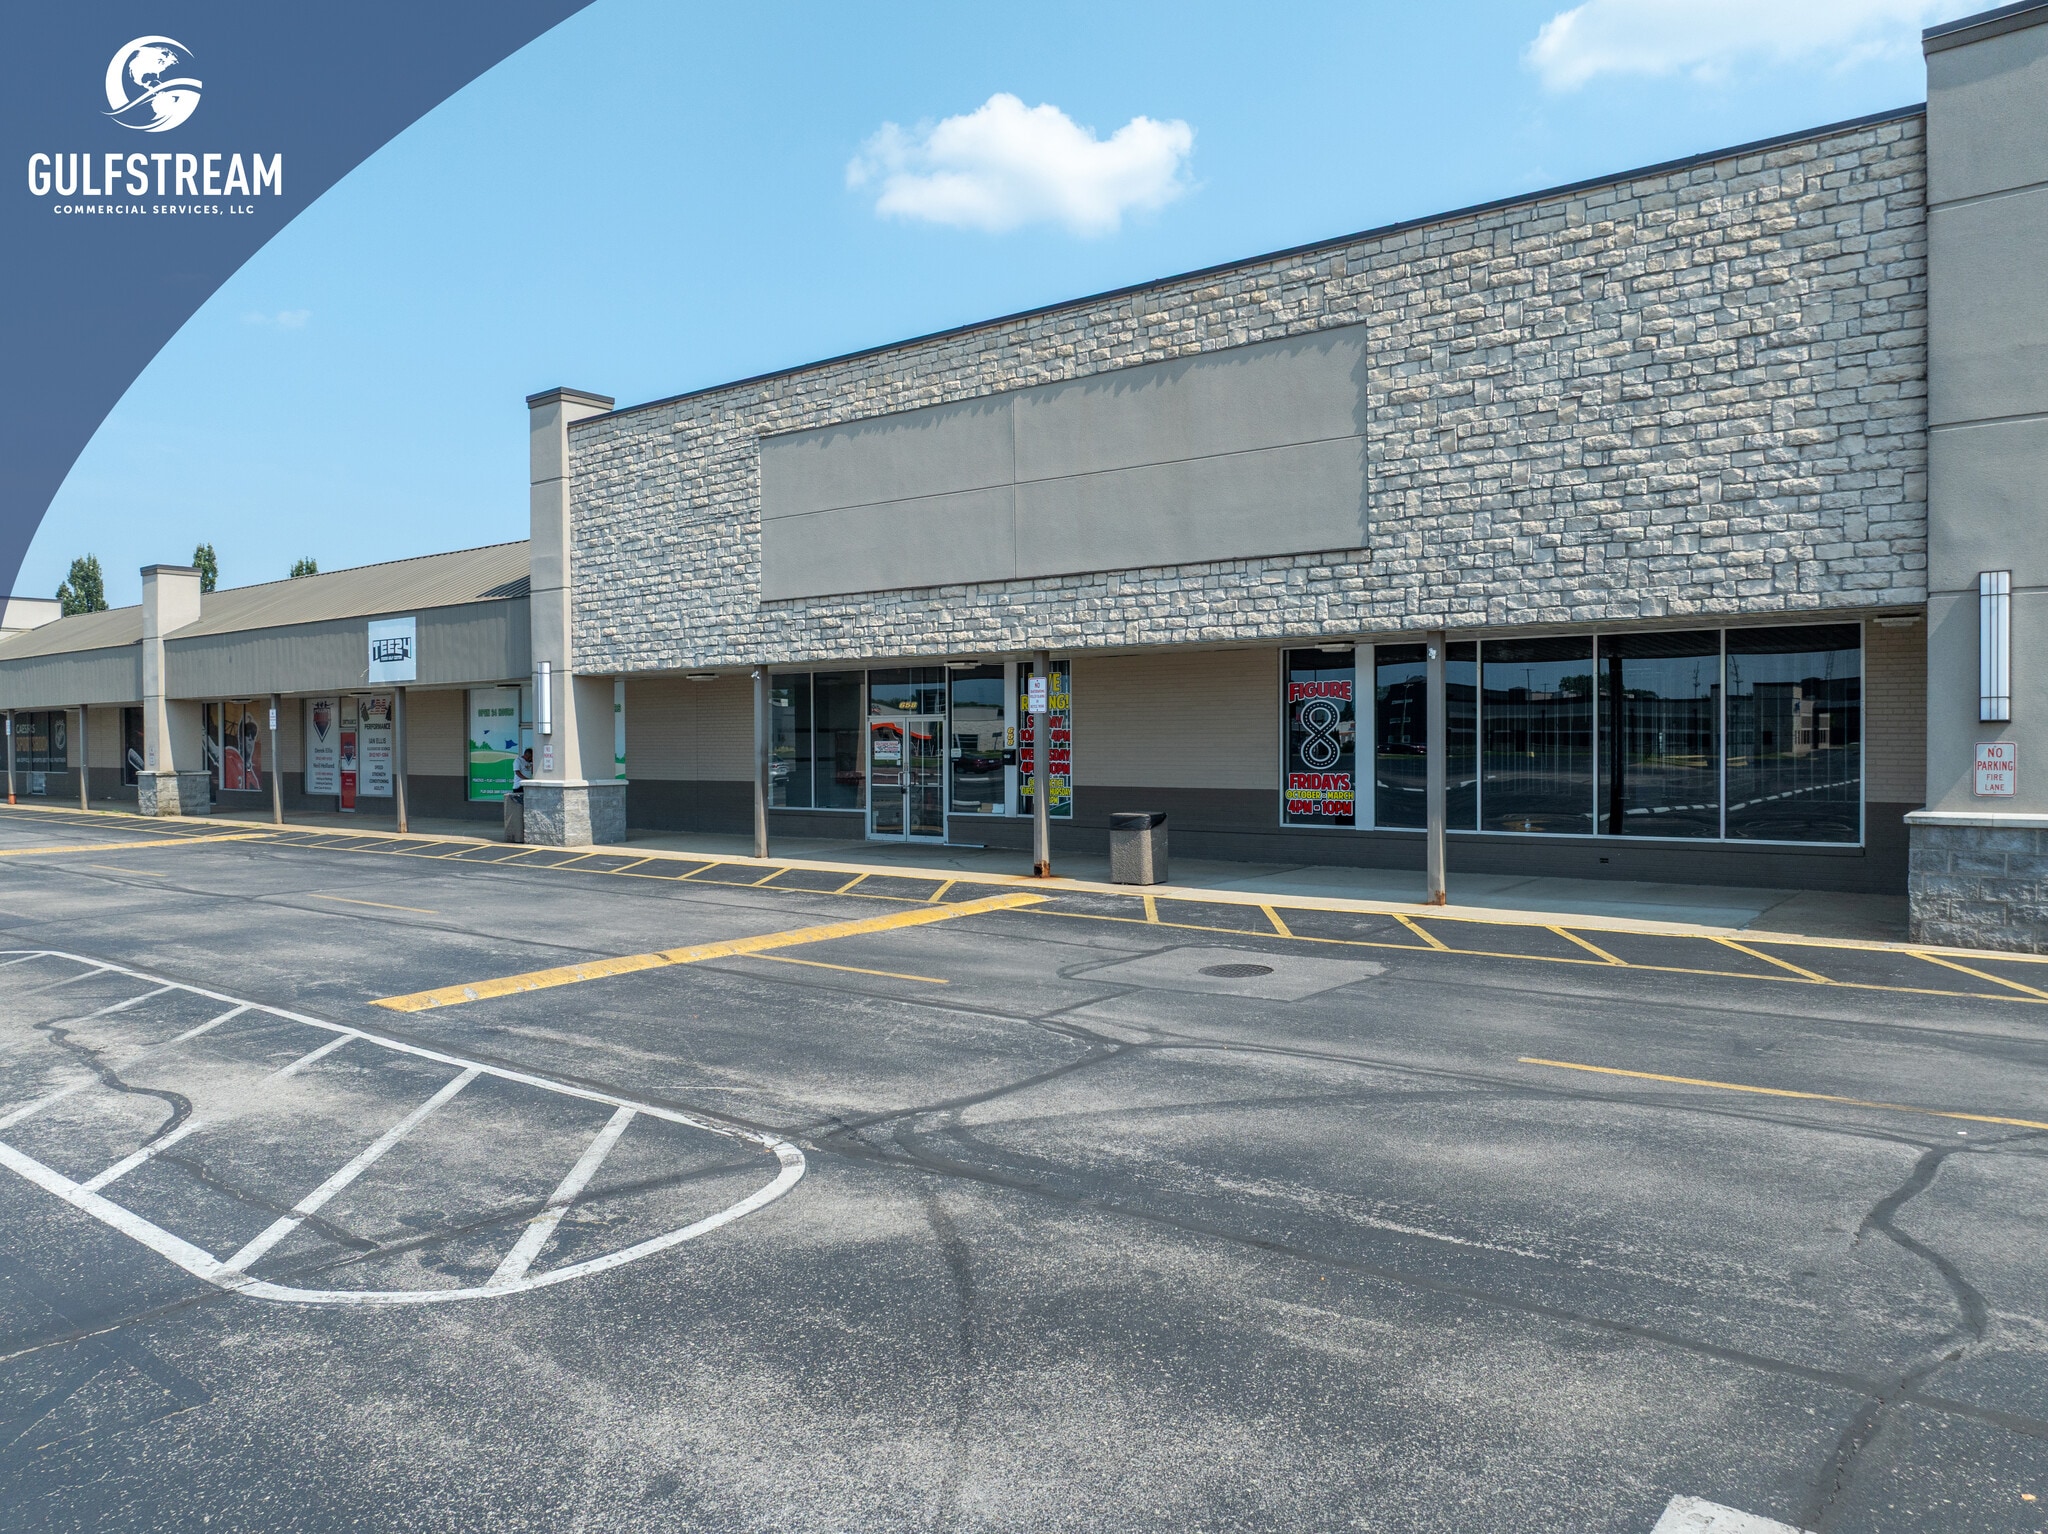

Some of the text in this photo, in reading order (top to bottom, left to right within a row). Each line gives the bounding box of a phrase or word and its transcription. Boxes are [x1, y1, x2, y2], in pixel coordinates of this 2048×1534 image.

[1288, 680, 1353, 702] FIGURE
[898, 701, 918, 710] 658
[1020, 693, 1070, 712] RNG!
[1300, 699, 1341, 770] 8
[1987, 747, 2003, 758] NO
[1977, 761, 2013, 771] PARKING
[1288, 773, 1351, 791] FRIDAYS
[1986, 773, 2004, 781] FIRE
[1984, 783, 2005, 791] LANE
[1285, 790, 1321, 800] OCTOBER
[1327, 790, 1355, 800] MARCH
[1287, 799, 1313, 815] 4PM
[1321, 800, 1354, 816] 10PM
